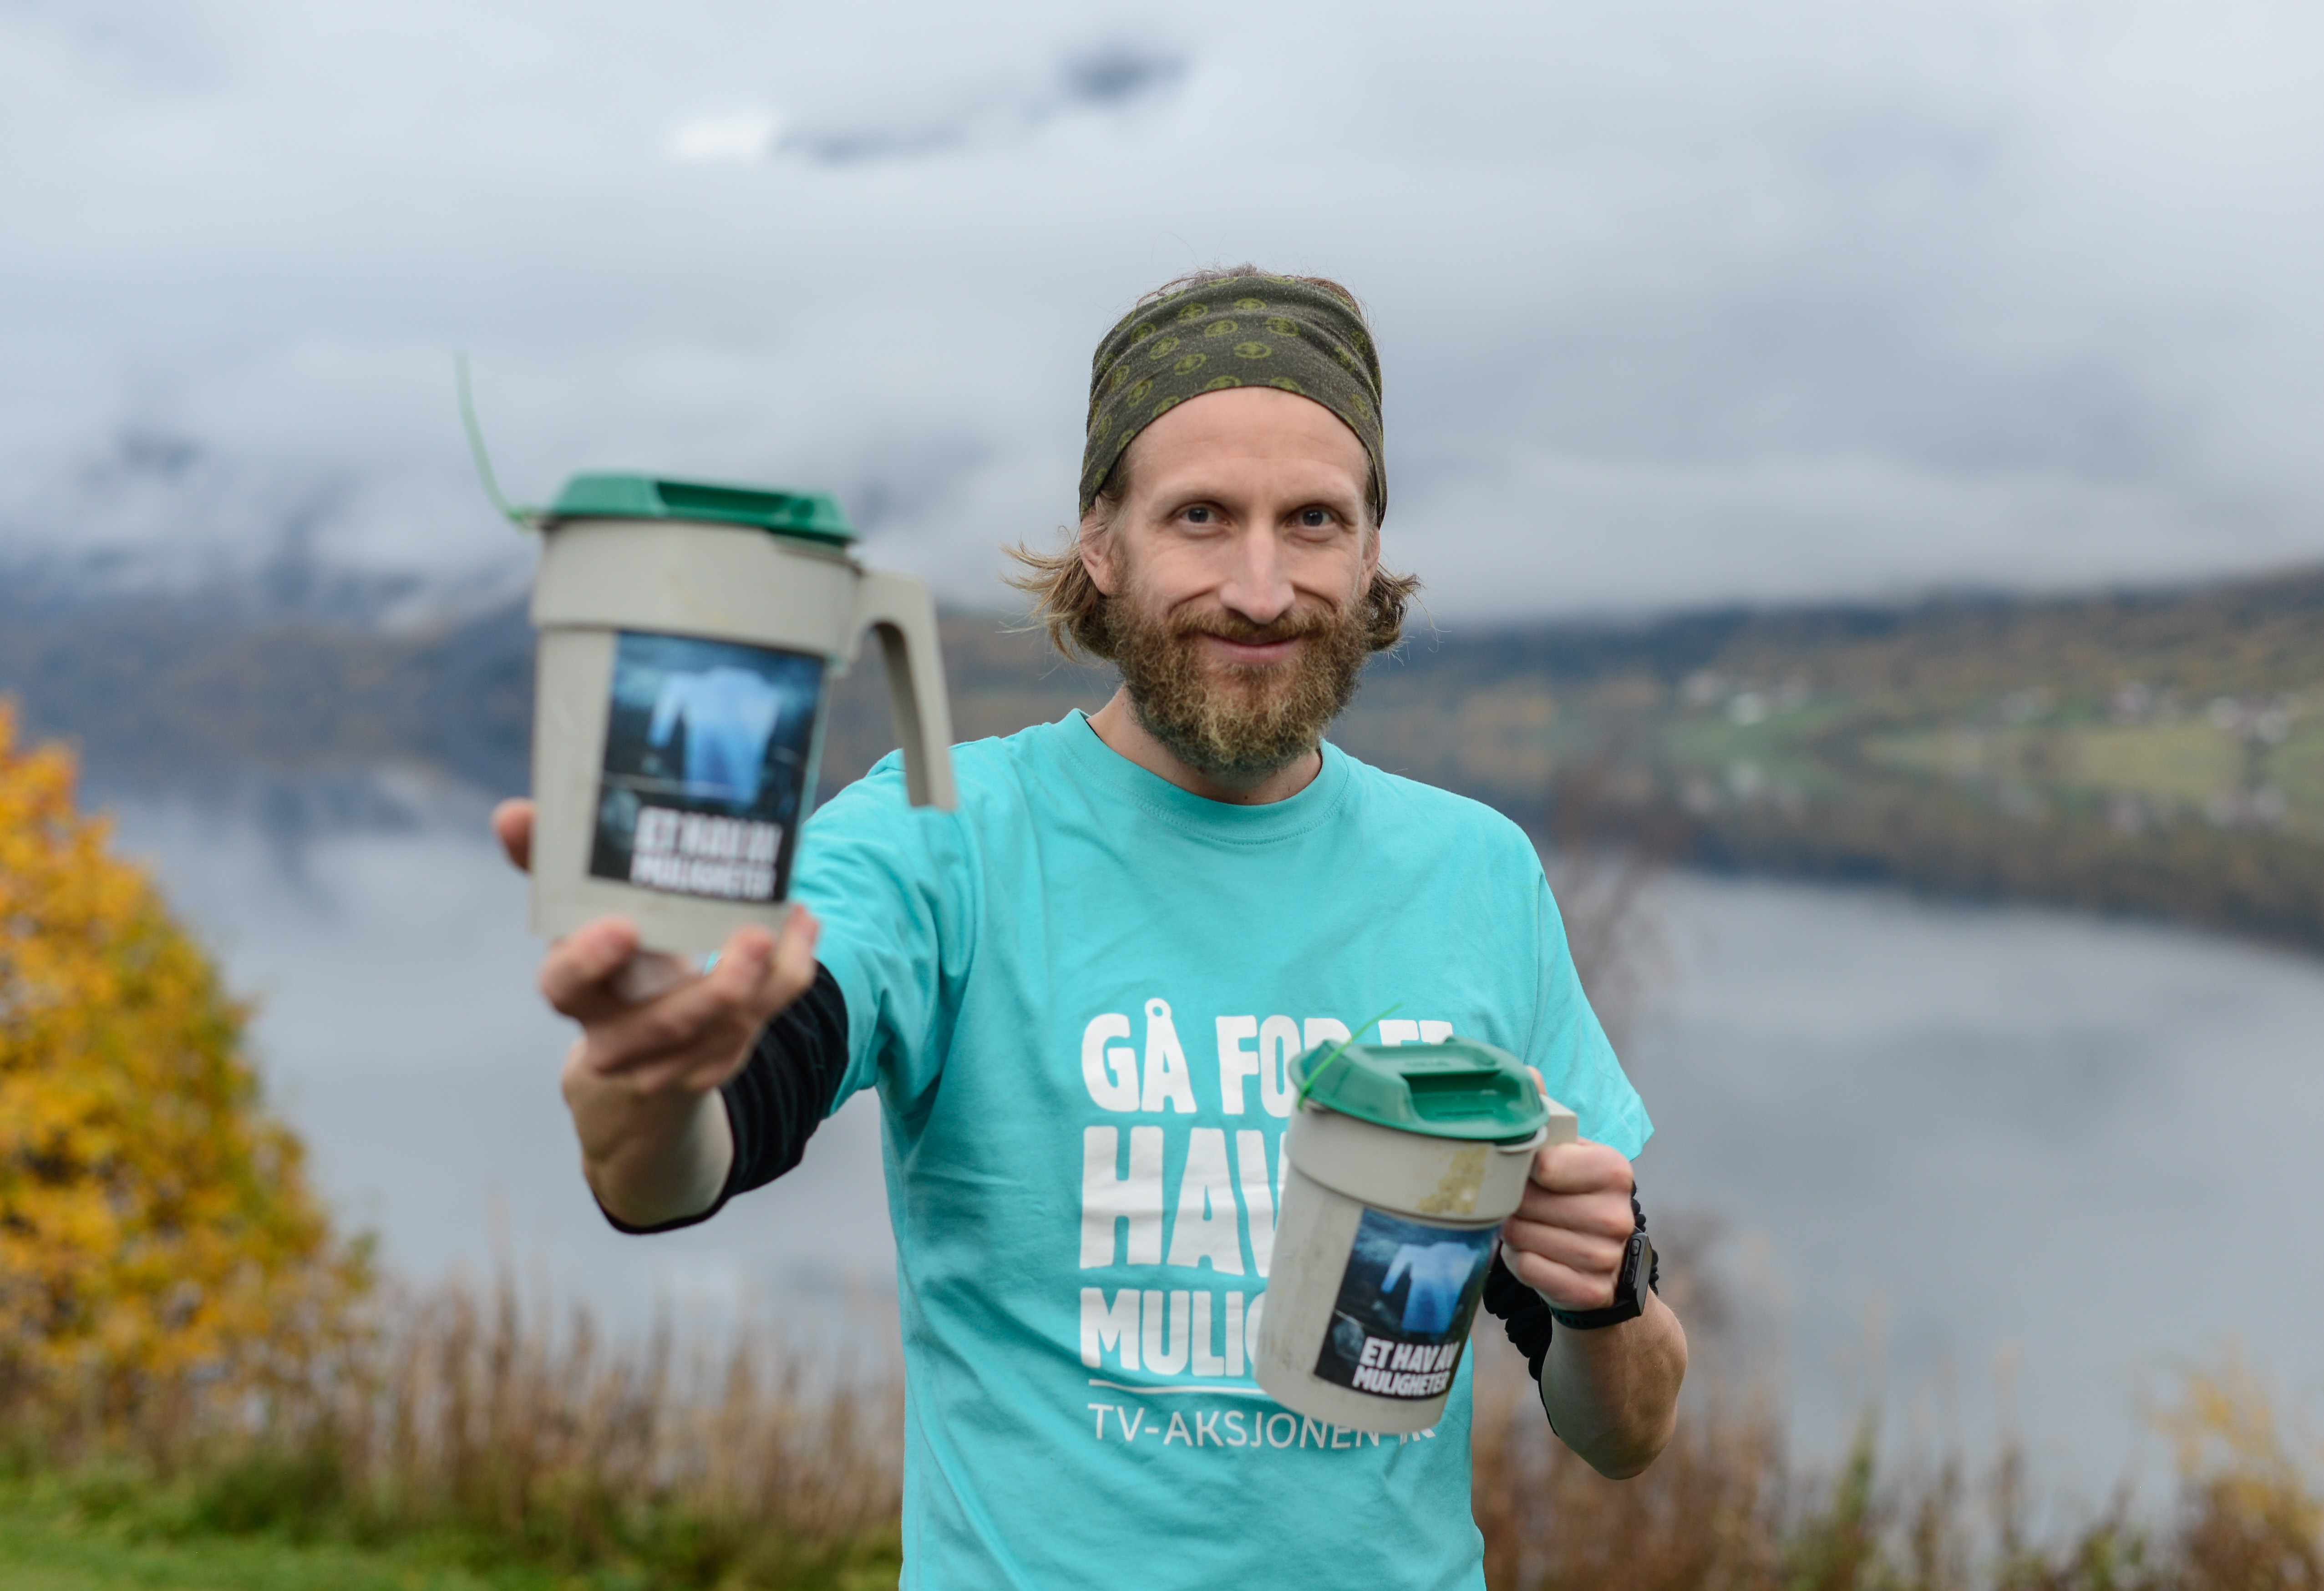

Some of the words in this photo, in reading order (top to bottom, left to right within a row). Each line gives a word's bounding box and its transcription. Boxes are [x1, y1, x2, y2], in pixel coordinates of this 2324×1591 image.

[1081, 998, 1198, 1114] GÅ
[1360, 1336, 1395, 1370] ET
[1390, 1343, 1441, 1373] HAV
[1352, 1364, 1451, 1396] MULIGHETER
